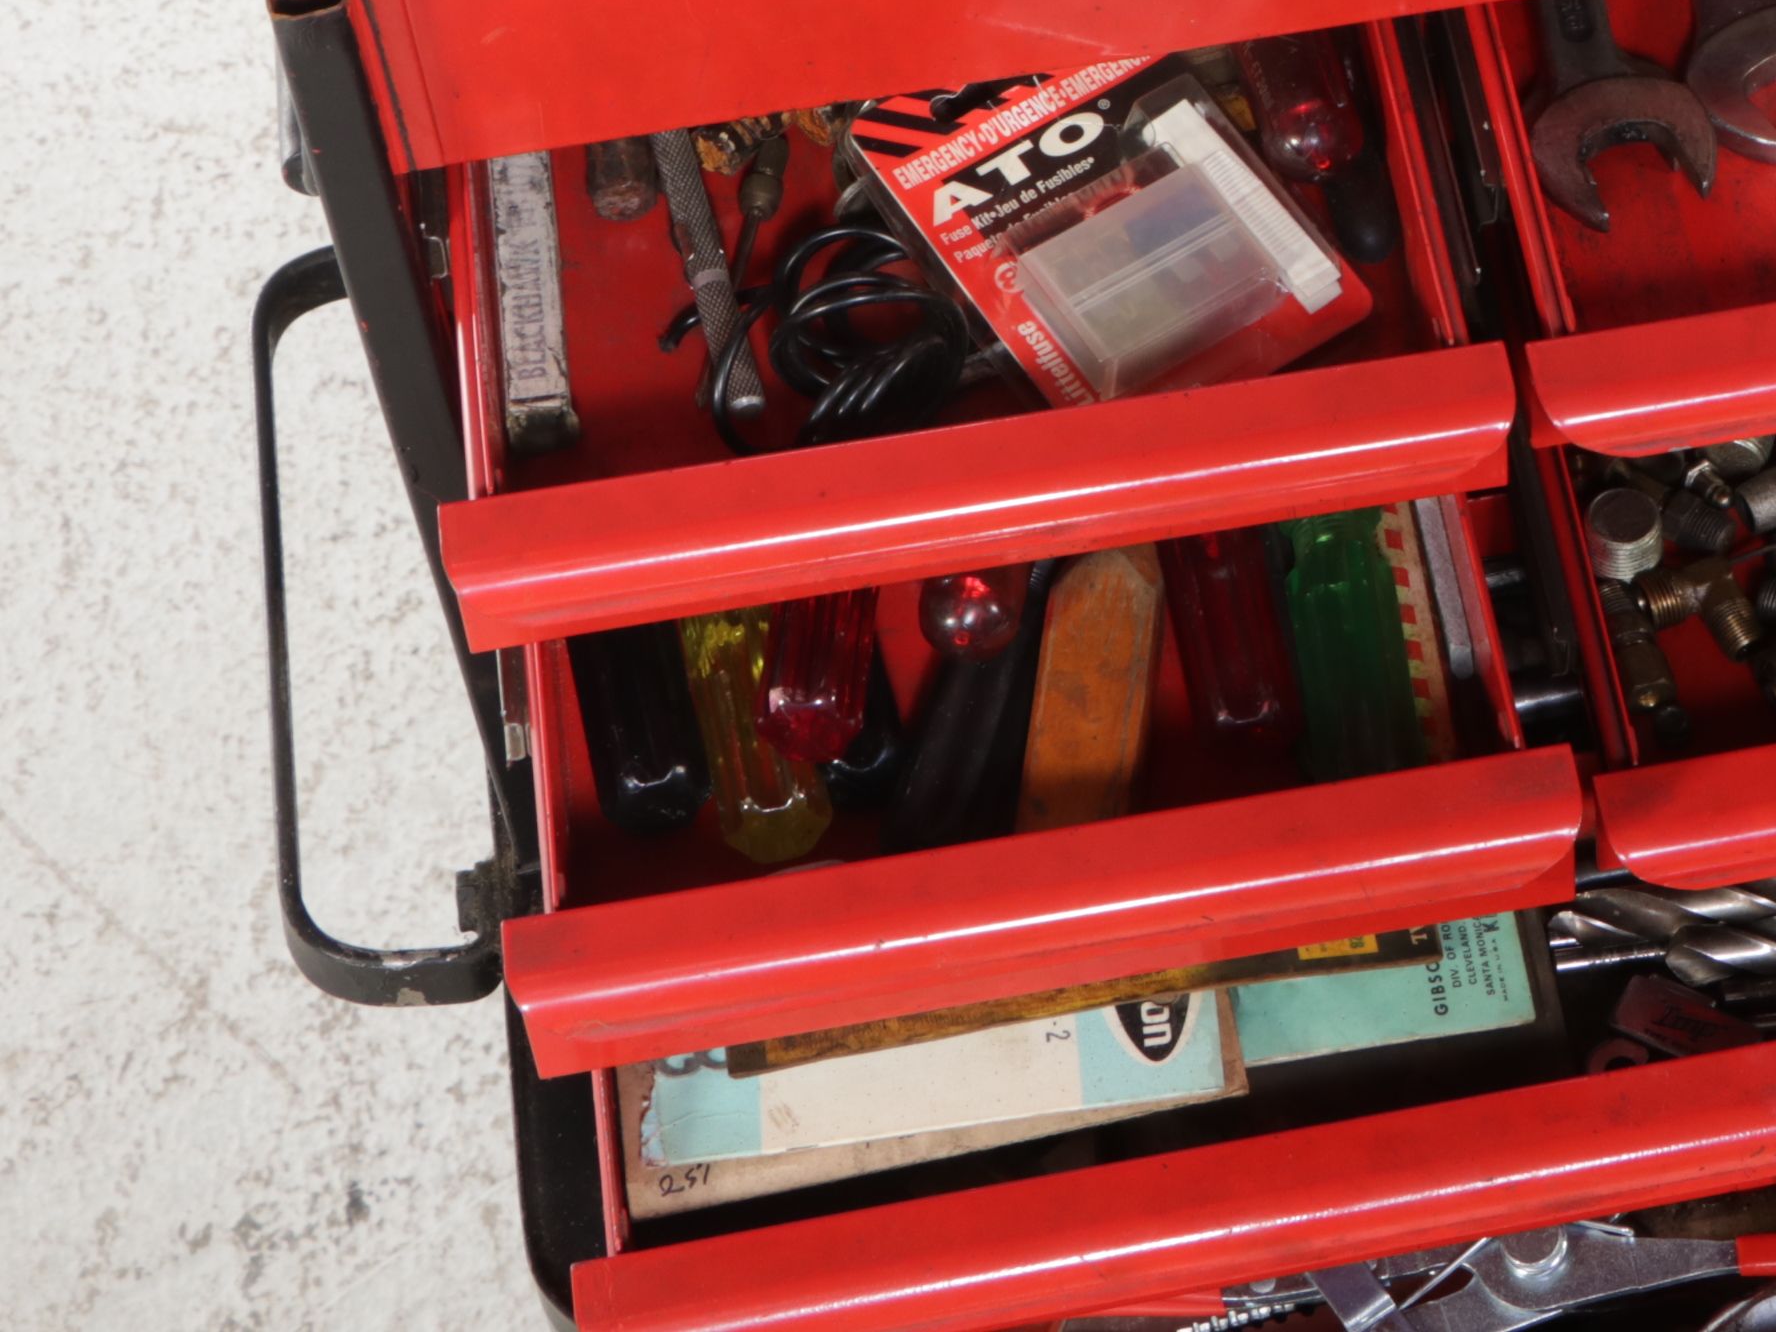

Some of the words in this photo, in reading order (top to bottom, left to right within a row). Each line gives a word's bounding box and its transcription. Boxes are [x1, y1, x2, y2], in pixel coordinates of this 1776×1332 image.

[891, 130, 985, 191] EMERGENCY
[979, 84, 1067, 146] D'URGENCE
[932, 111, 1105, 228] ATO
[939, 223, 974, 246] Fuse
[972, 210, 991, 231] Kit
[995, 198, 1019, 218] Jeu
[1018, 183, 1038, 203] de
[1037, 158, 1090, 192] Fusibles
[1446, 942, 1457, 961] OF
[1481, 960, 1496, 996] SANTA
